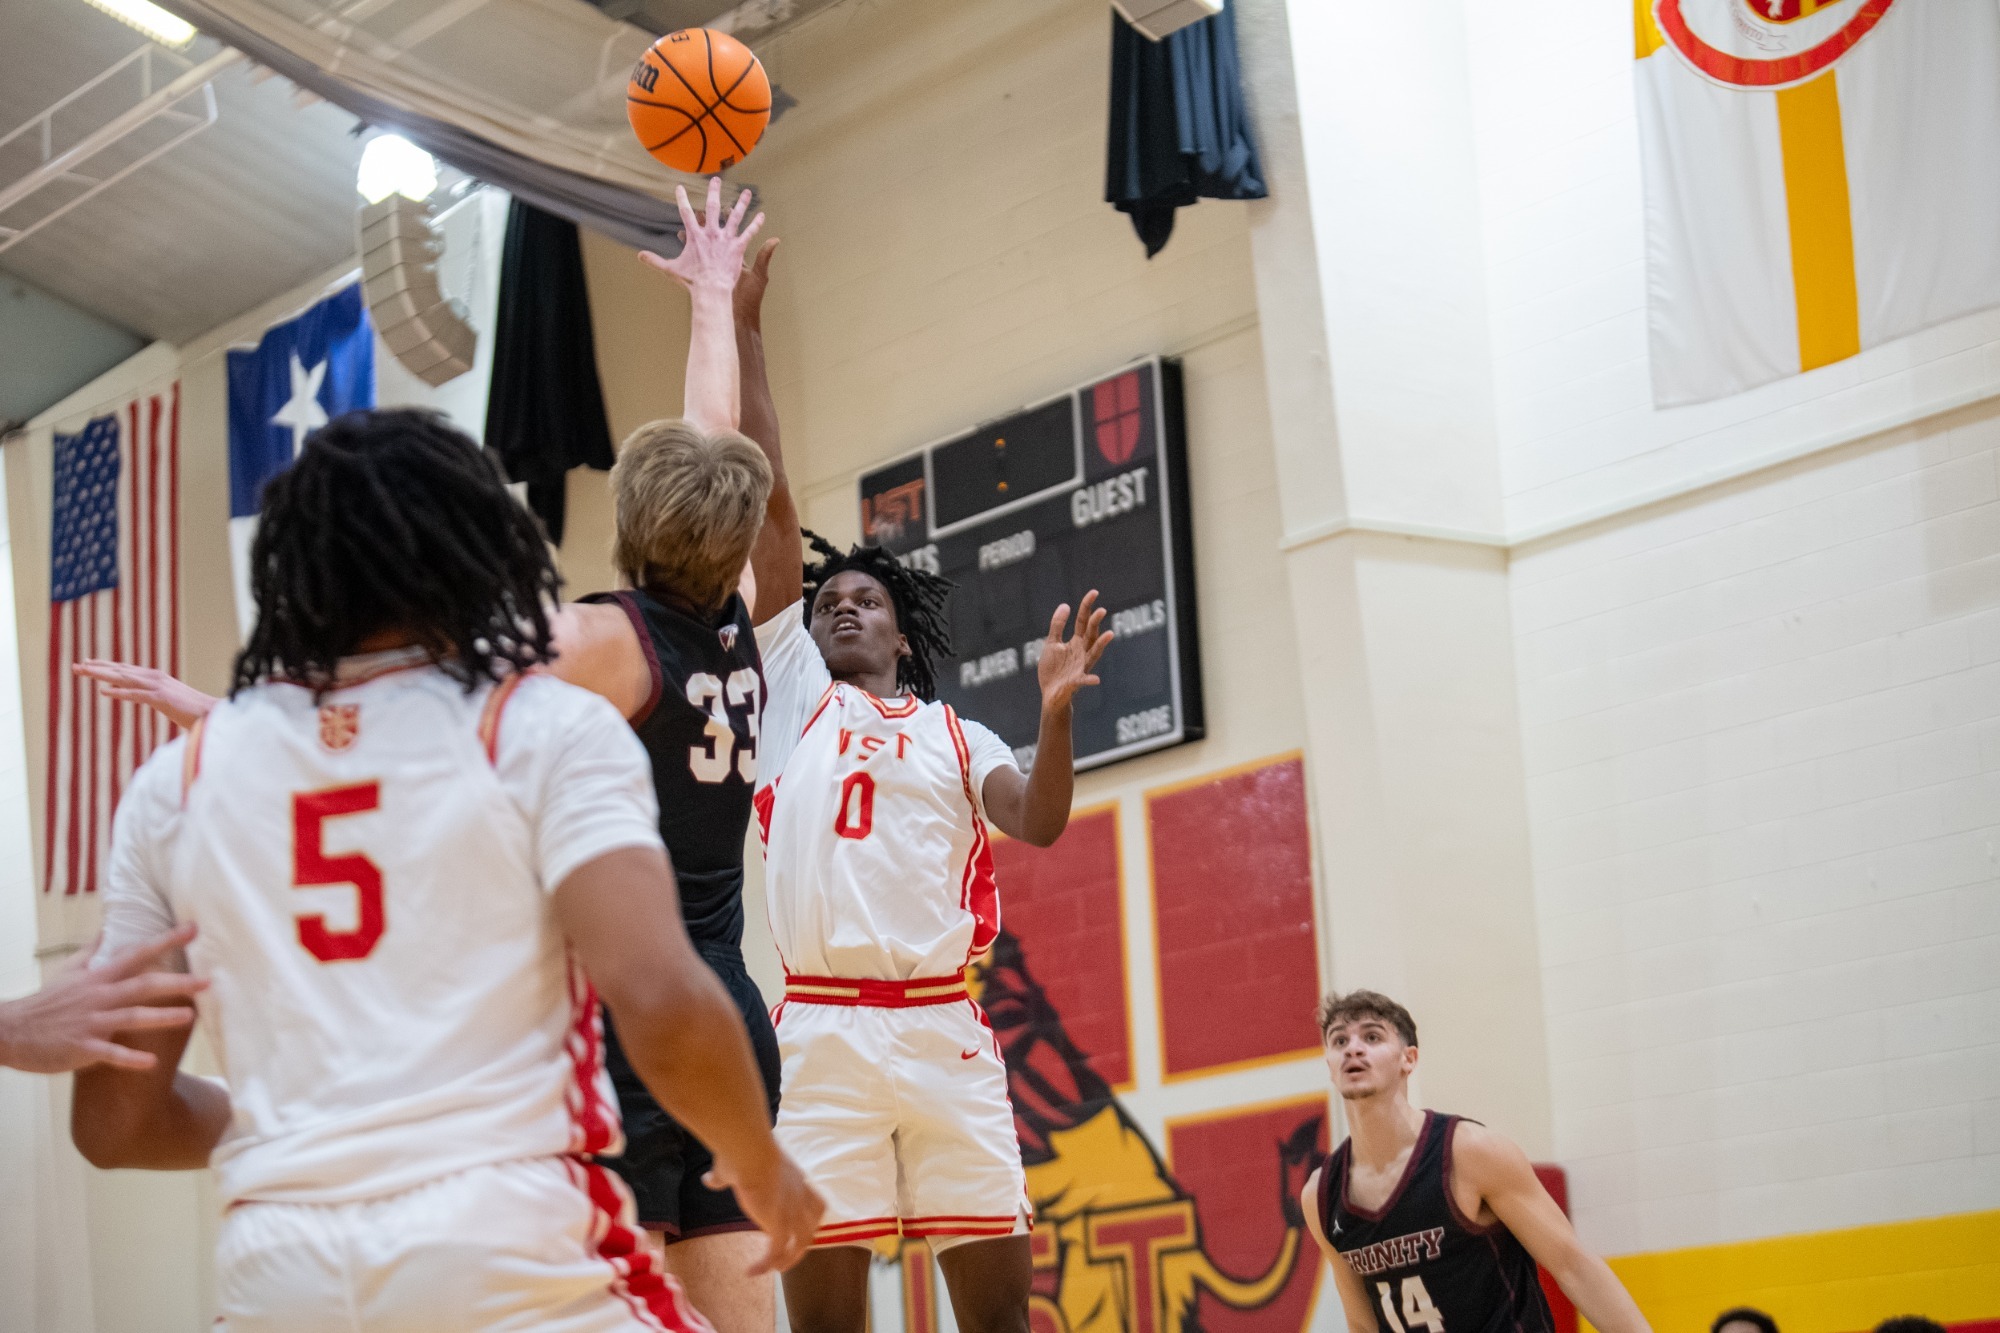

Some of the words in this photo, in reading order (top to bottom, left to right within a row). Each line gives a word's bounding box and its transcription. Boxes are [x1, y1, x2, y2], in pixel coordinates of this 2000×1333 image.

[1071, 467, 1148, 528] GUEST
[979, 530, 1036, 572] PERIOD
[1112, 599, 1165, 637] FOULS
[960, 648, 1019, 688] PLAYER
[685, 667, 760, 785] 33
[1116, 705, 1170, 744] SCORE
[834, 770, 876, 841] 0
[291, 777, 385, 963] 5
[1375, 1275, 1446, 1333] 14
